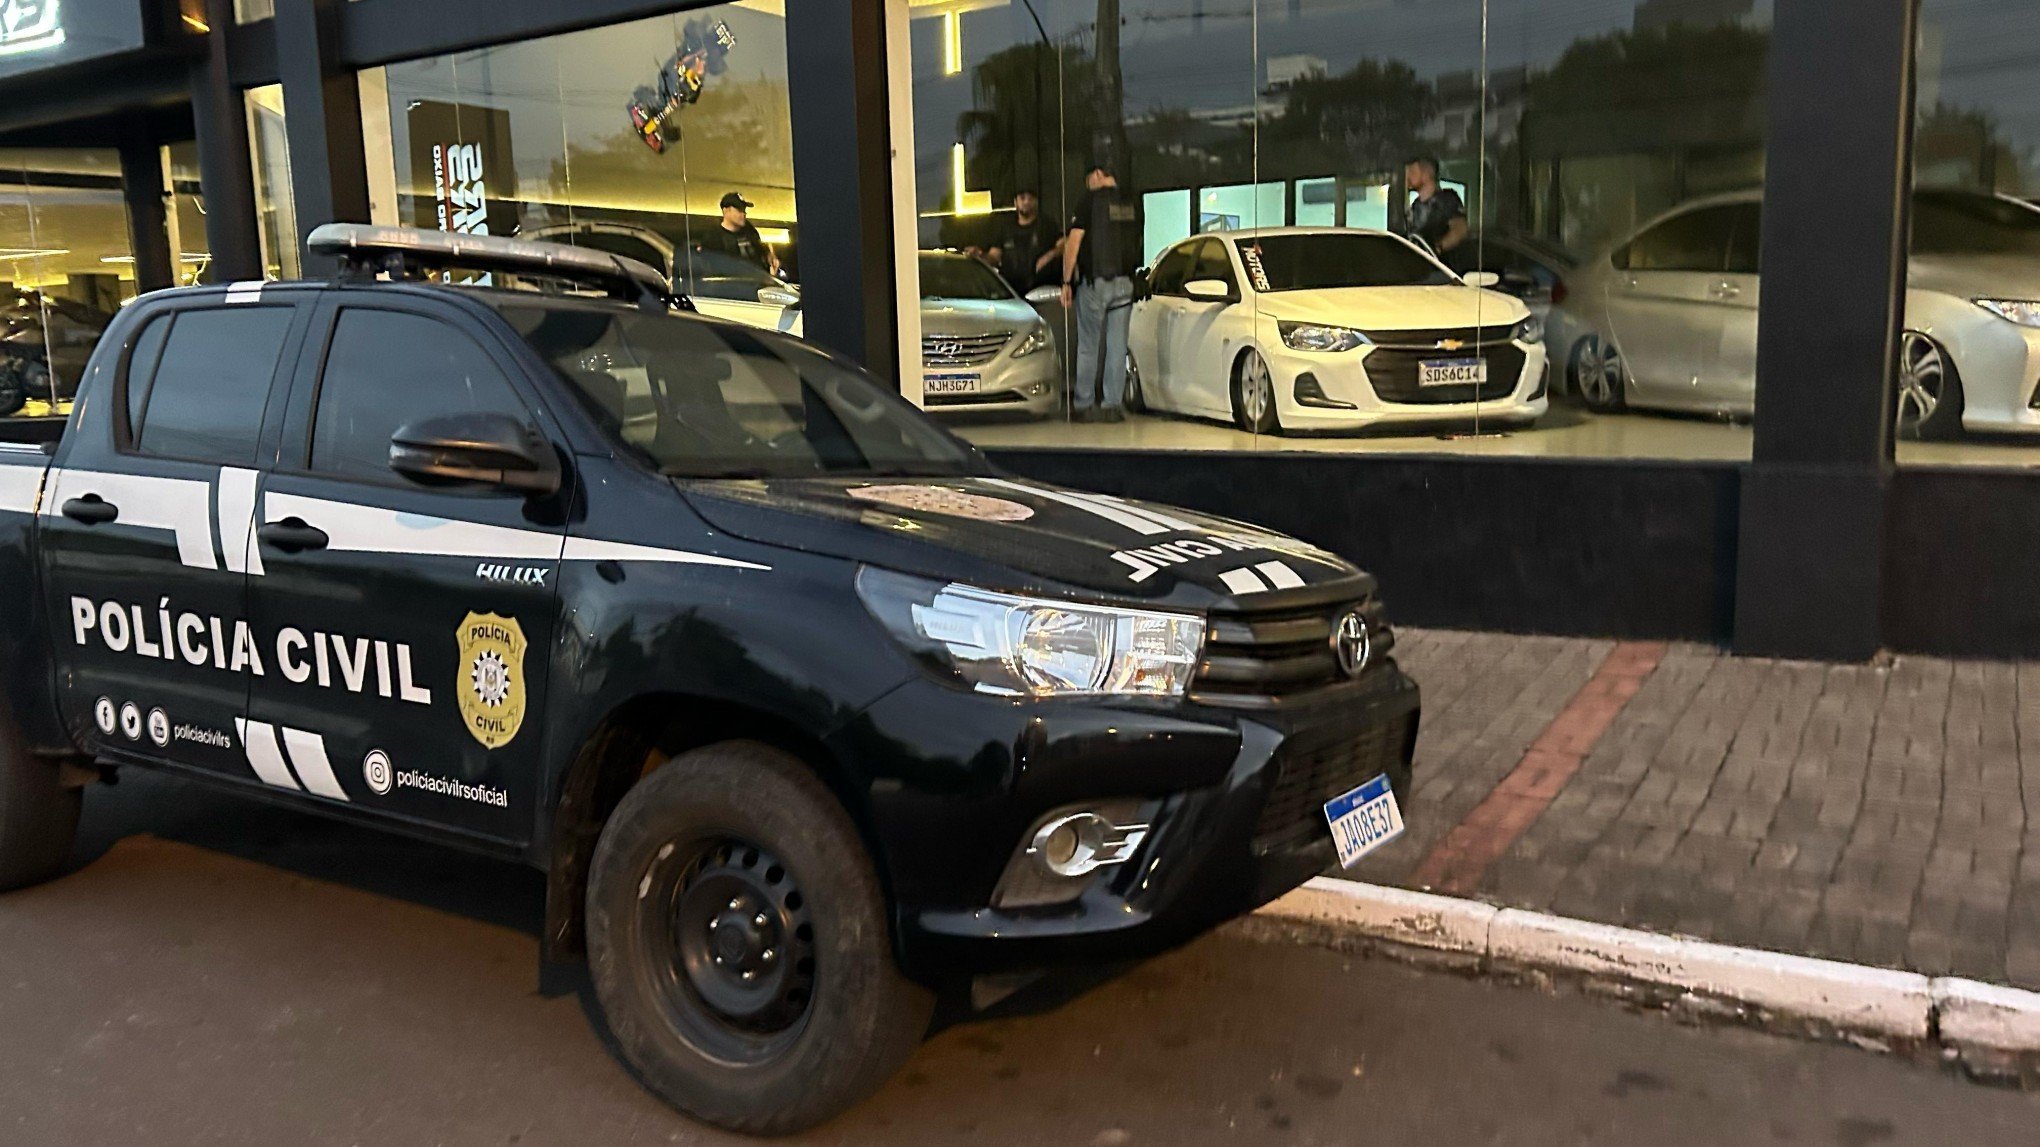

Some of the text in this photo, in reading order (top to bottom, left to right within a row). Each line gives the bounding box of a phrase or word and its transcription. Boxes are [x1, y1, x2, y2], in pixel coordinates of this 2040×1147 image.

[928, 380, 975, 392] NJH3G71
[475, 563, 549, 588] HILUX
[471, 622, 512, 647] POLÍCIA
[71, 596, 432, 705] POLÍCIA CIVIL
[174, 723, 231, 749] policiacivilrs
[475, 715, 506, 733] CIVIL
[397, 769, 508, 808] policiacivilrsoficial
